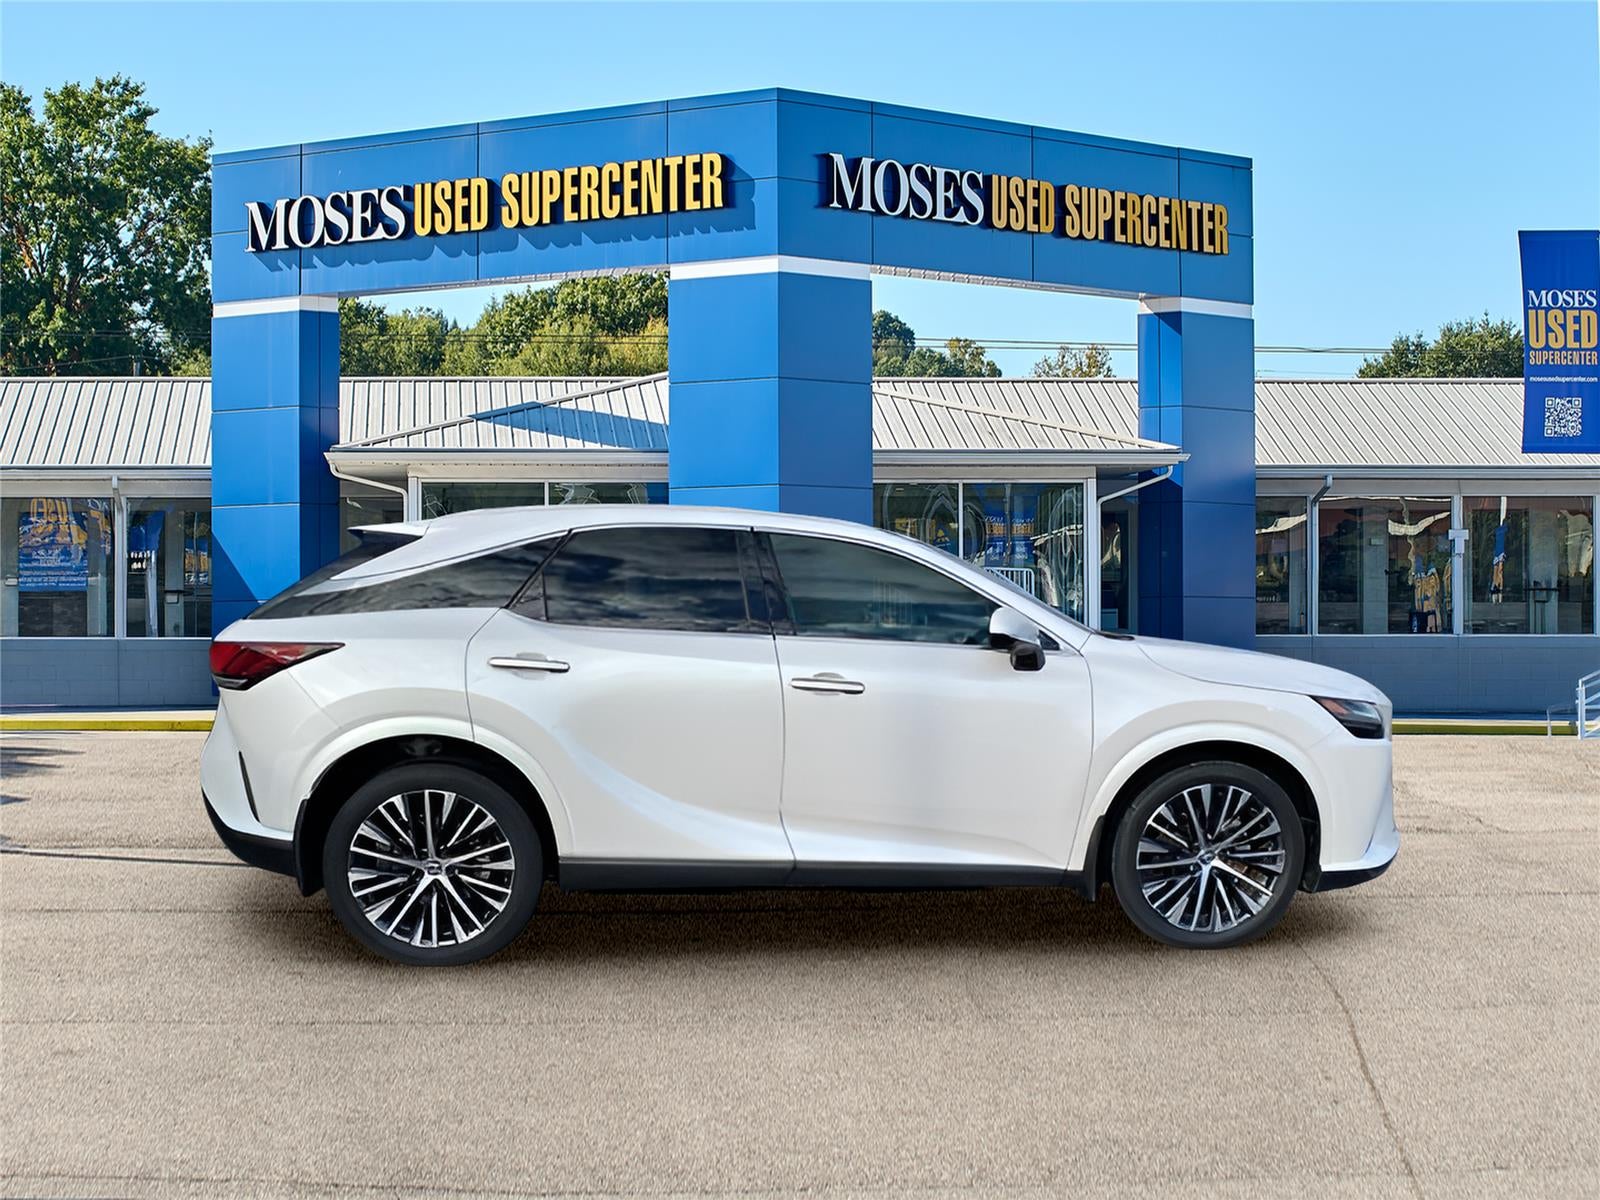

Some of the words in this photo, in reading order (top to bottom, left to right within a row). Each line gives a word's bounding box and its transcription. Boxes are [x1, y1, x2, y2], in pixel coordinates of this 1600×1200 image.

[244, 185, 406, 253] MOSES
[413, 176, 488, 237] USED
[501, 152, 724, 229] SUPERCENTER
[829, 152, 984, 226] MOSES
[991, 173, 1056, 233] USED
[1065, 184, 1230, 255] SUPERCENTER
[1528, 289, 1597, 308] MOSES
[1528, 309, 1598, 349] USED
[1529, 350, 1598, 366] SUPERCENTER
